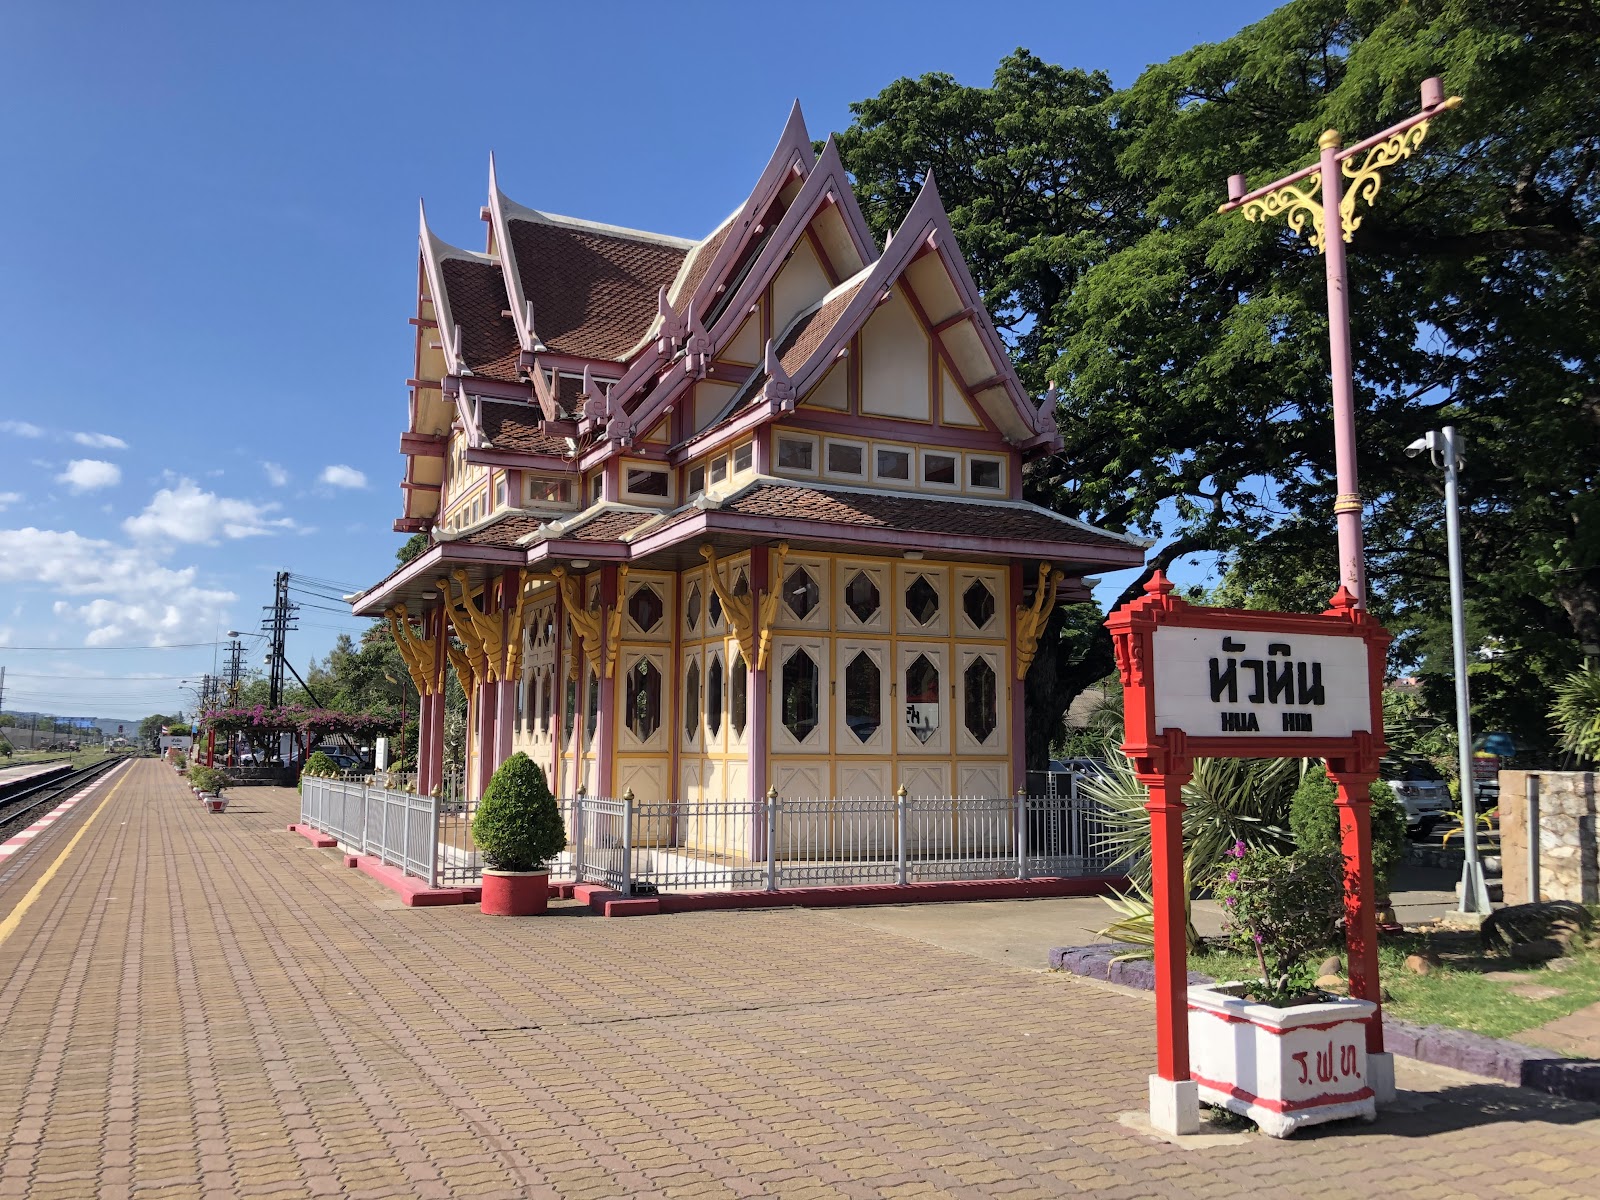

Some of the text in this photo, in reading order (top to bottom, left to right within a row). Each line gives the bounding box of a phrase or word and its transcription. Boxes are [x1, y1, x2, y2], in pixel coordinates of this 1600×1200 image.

[1208, 636, 1325, 705] หัวหิน
[1221, 712, 1313, 732] HUA HIN
